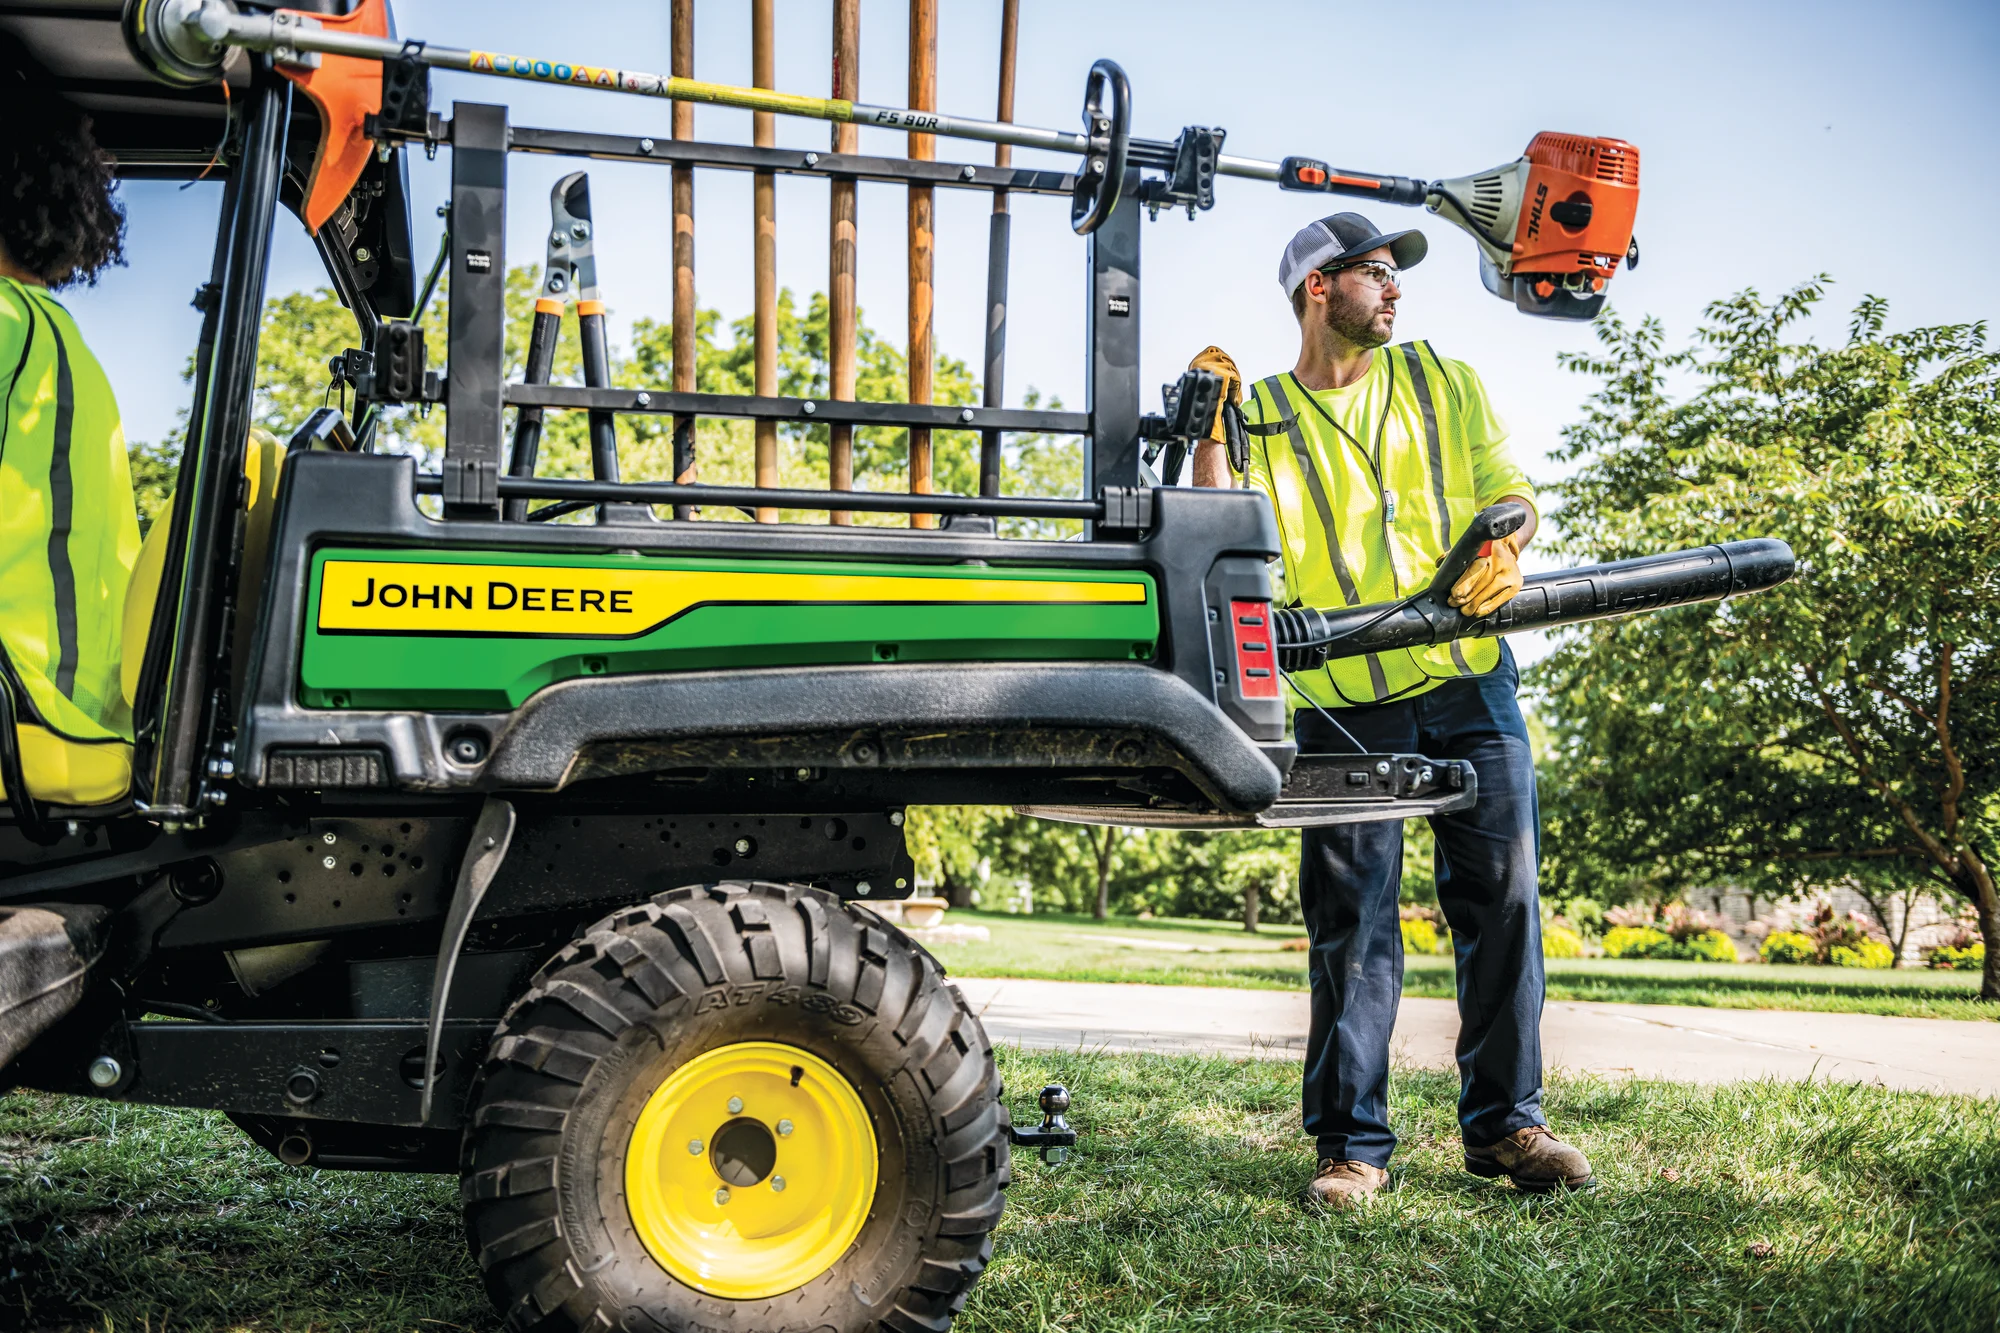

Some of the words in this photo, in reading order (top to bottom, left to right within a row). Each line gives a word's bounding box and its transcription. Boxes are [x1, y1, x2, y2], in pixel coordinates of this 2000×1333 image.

[876, 111, 899, 124] FS
[1528, 182, 1548, 241] STIHL
[352, 578, 473, 610] JOHN
[488, 581, 633, 613] DEERE
